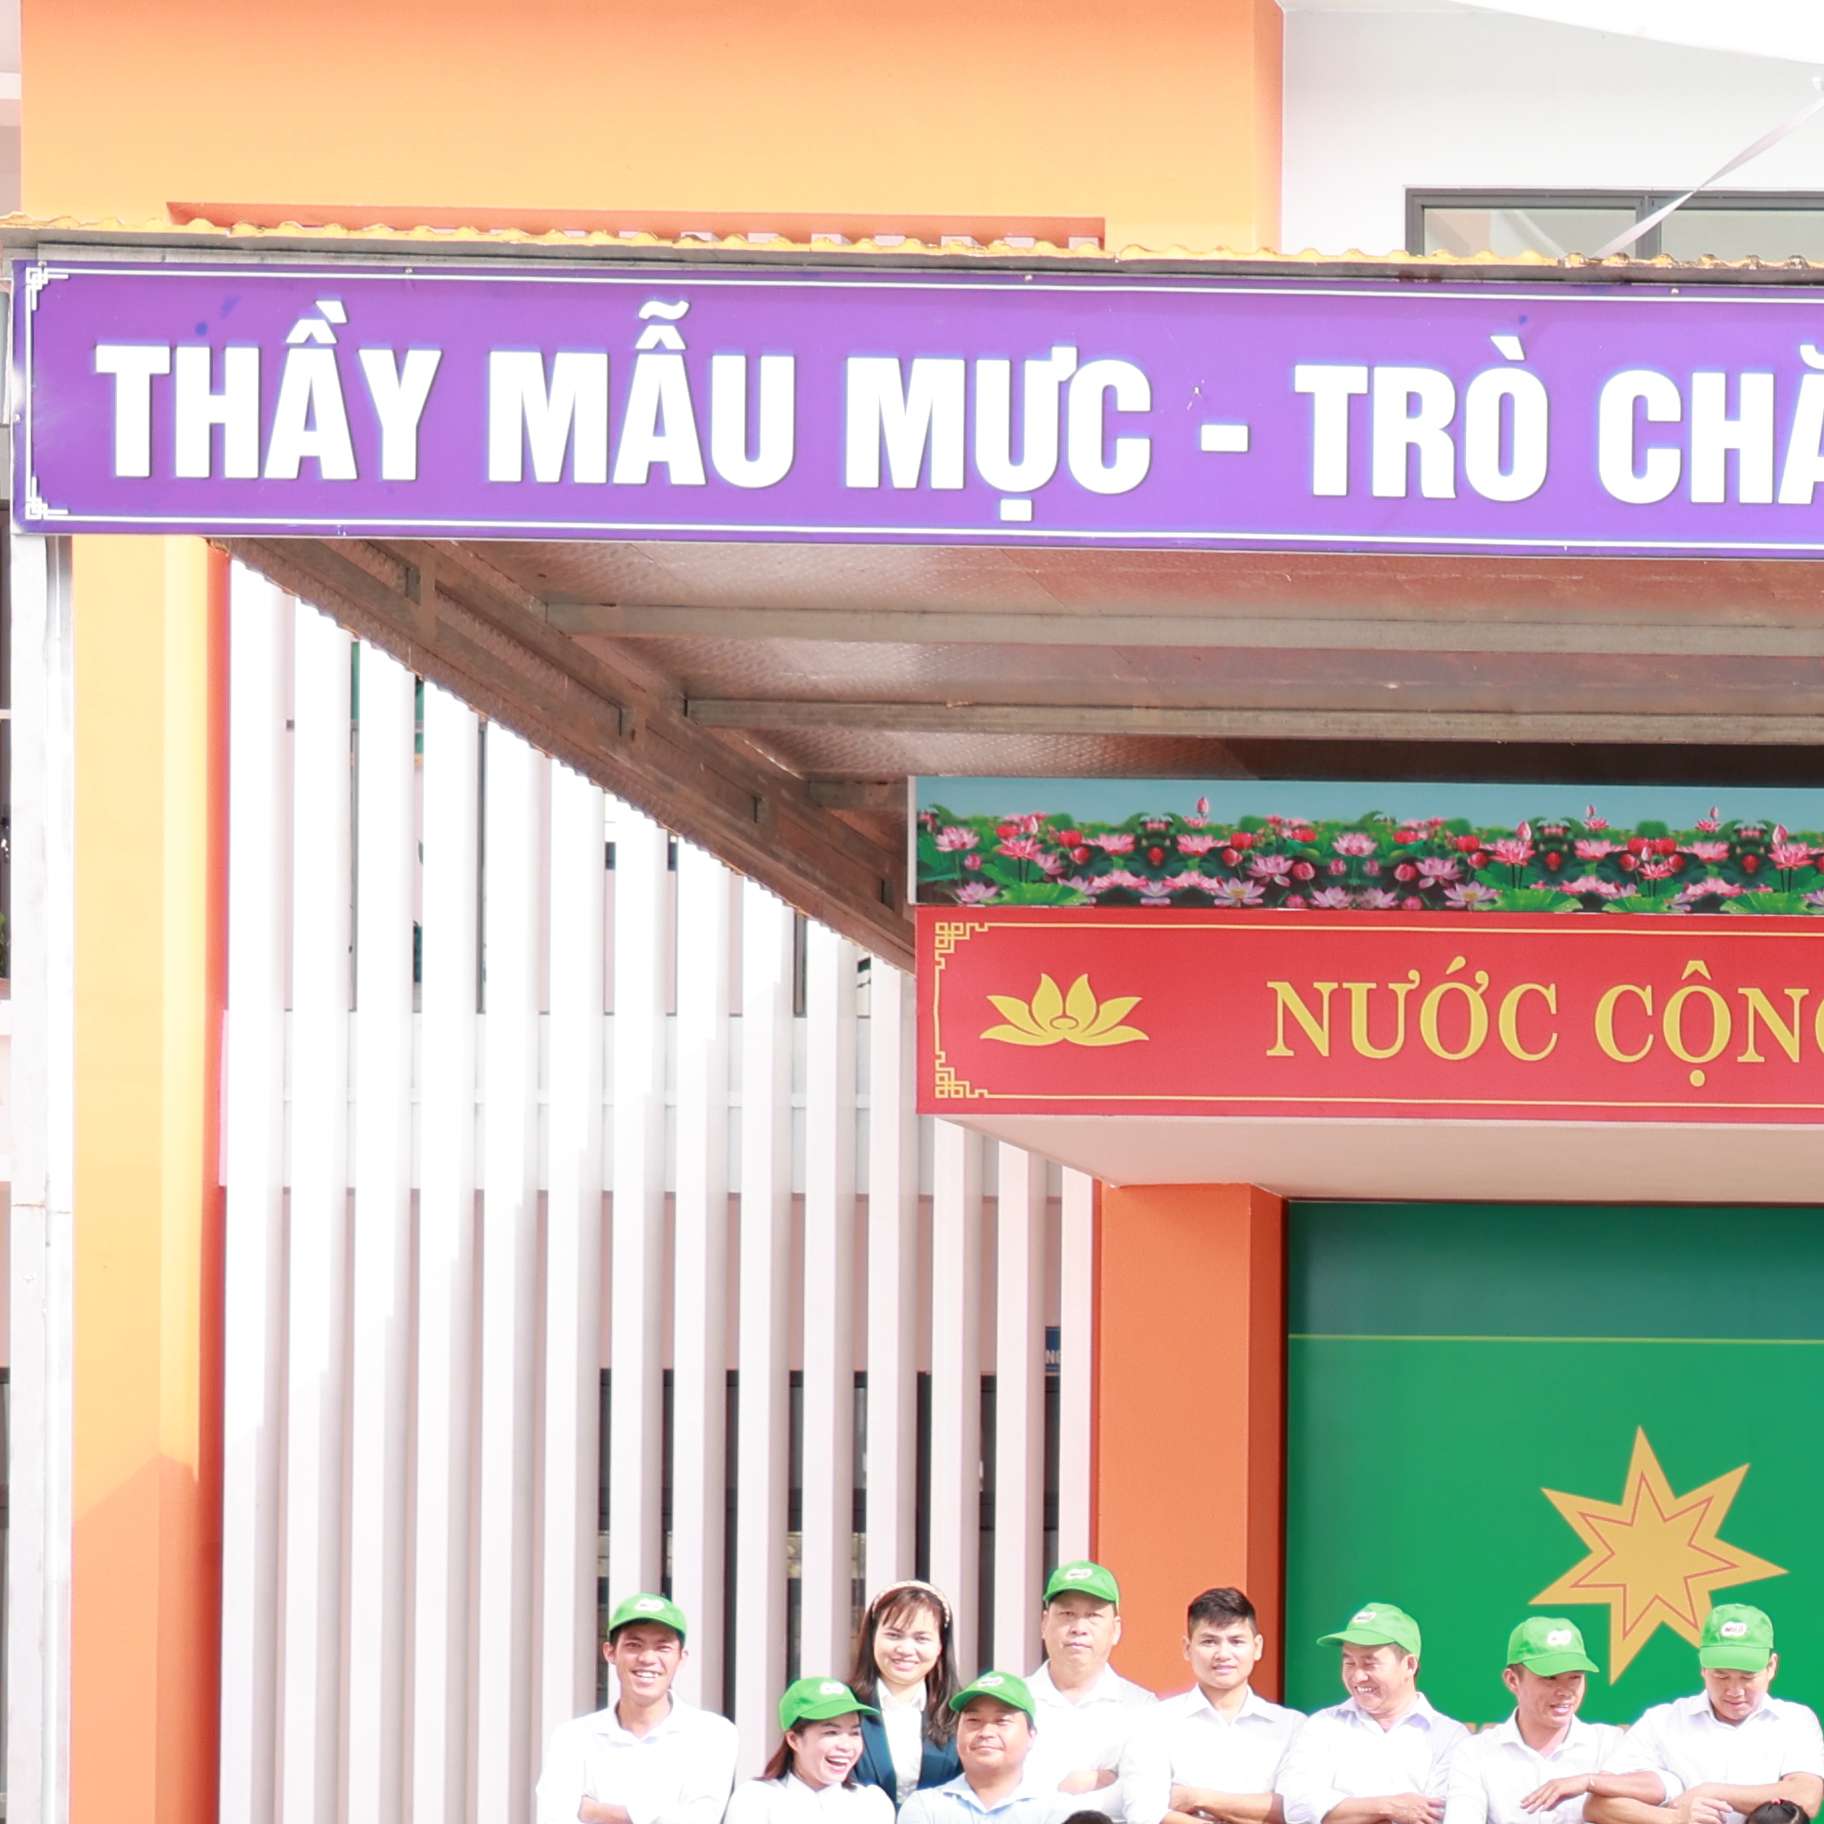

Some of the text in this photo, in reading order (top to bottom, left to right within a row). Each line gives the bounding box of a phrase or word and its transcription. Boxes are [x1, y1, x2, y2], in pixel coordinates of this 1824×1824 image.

[96, 301, 441, 480] THẦY
[489, 301, 794, 488] MẪU
[846, 346, 1151, 521] MỰC
[1201, 424, 1248, 452] -
[1295, 336, 1548, 501] TRÒ
[1265, 957, 1560, 1061] NƯỚC
